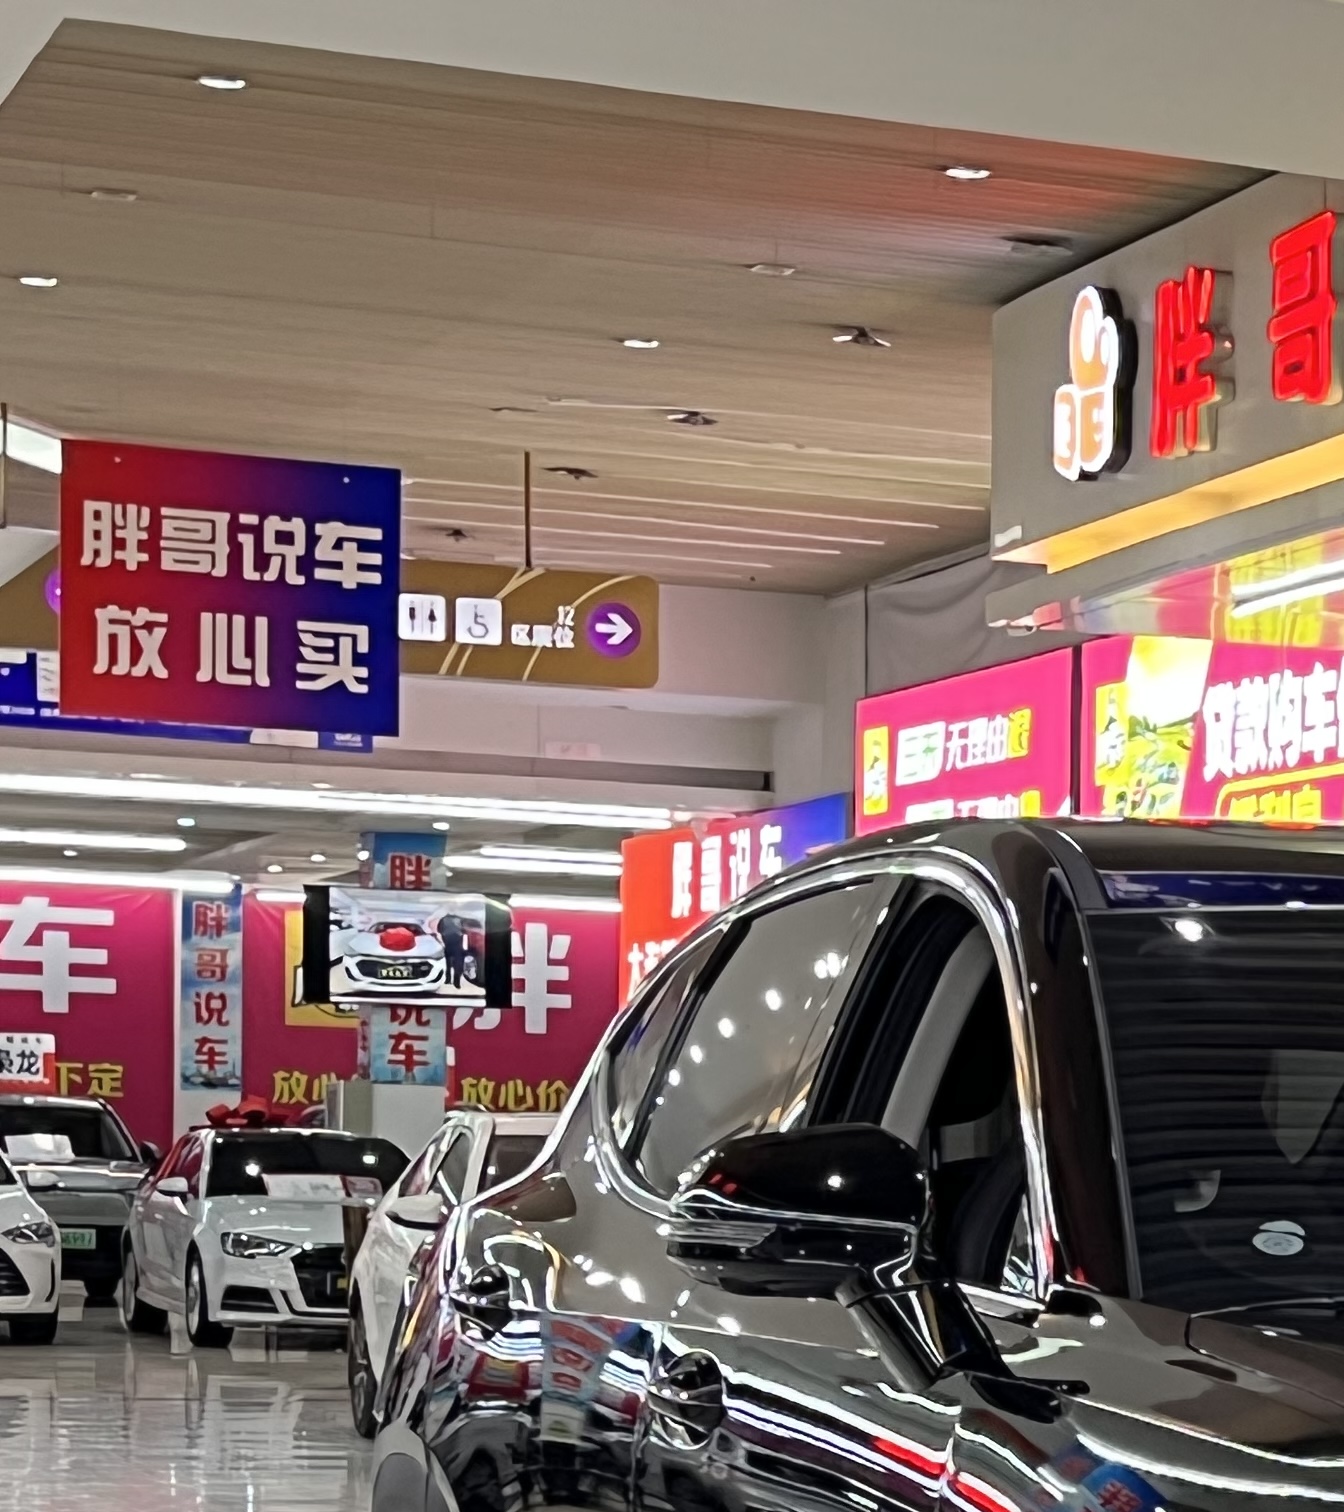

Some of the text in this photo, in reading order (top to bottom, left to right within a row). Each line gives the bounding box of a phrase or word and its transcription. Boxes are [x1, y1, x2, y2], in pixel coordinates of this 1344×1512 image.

[1150, 210, 1338, 458] 胖哥
[80, 499, 383, 590] 胖哥说车
[92, 604, 370, 695] 放心买
[194, 900, 229, 1072] 胖哥说车
